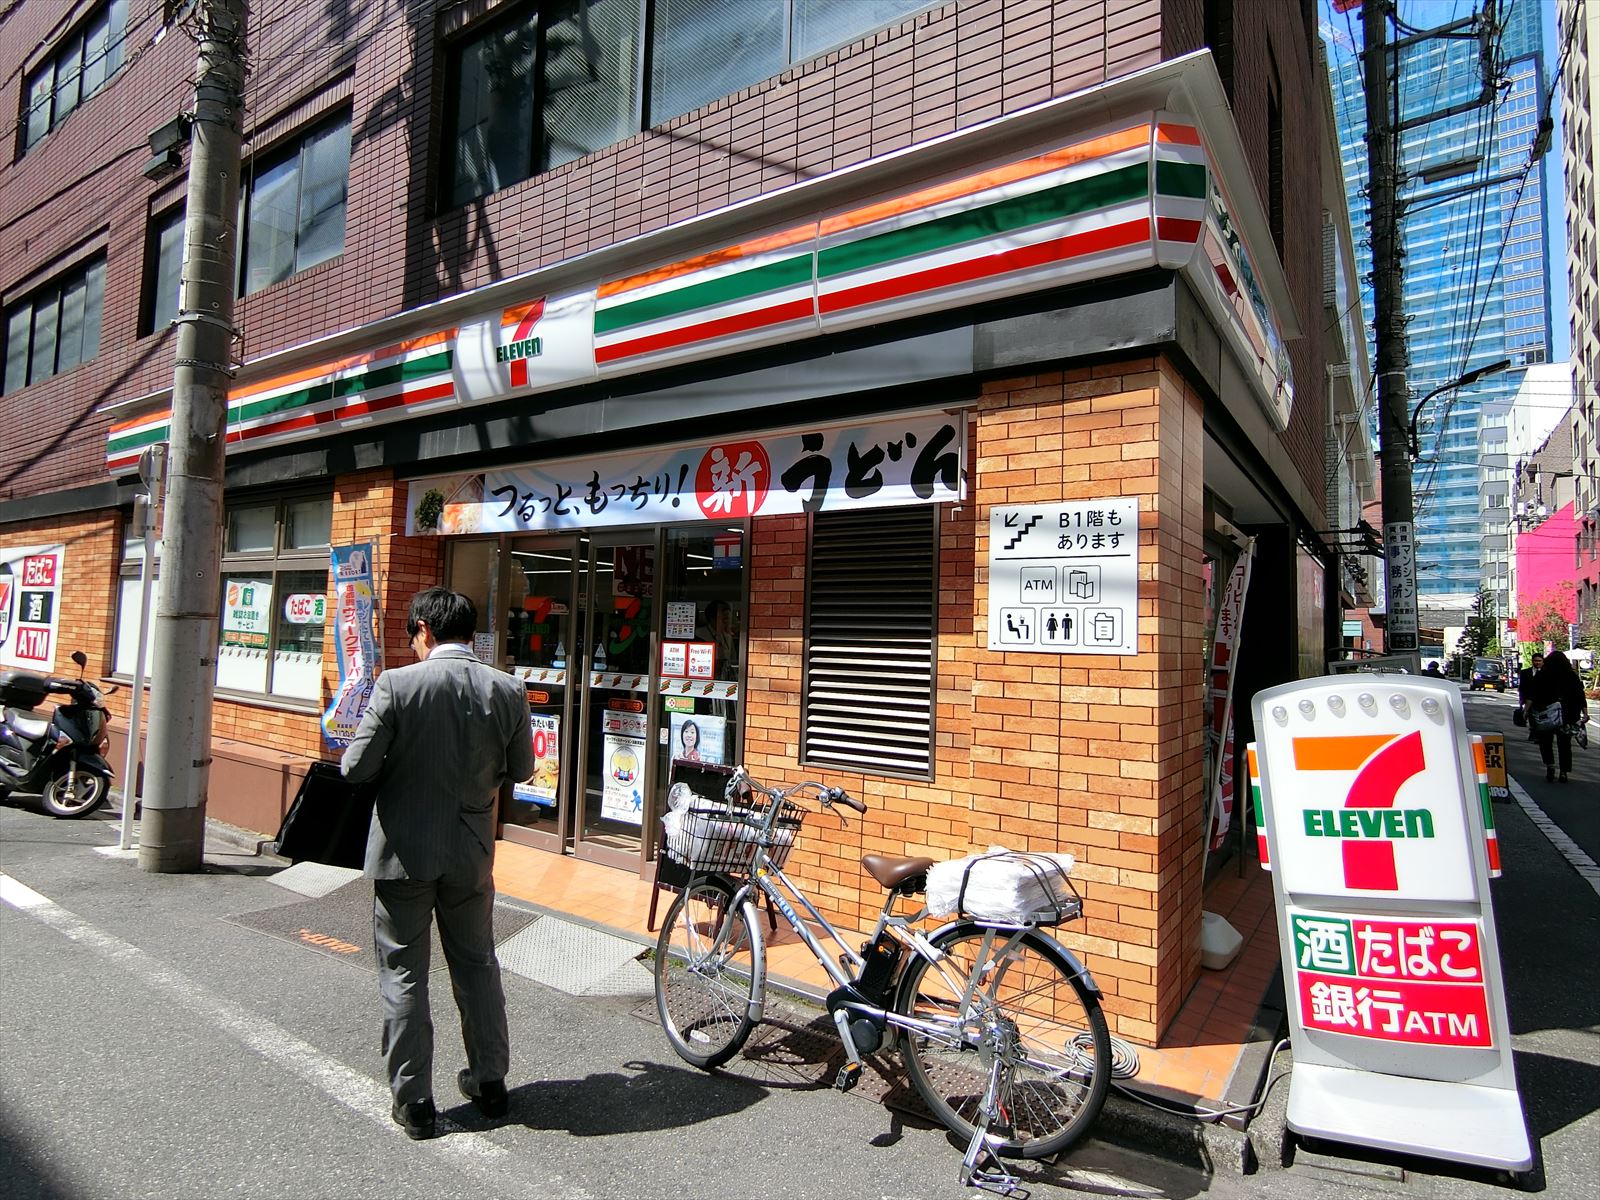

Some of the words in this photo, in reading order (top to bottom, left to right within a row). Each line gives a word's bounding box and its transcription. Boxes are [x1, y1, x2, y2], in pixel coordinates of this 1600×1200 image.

[702, 447, 763, 515] 新
[781, 424, 960, 512] うどん
[1057, 531, 1125, 550] あります
[25, 558, 53, 584] たばこ
[1024, 579, 1053, 591] ATM
[1390, 545, 1403, 598] 事務所
[1401, 544, 1413, 598] マンション
[28, 594, 44, 621] 酒
[290, 598, 311, 616] たばこ
[314, 598, 324, 616] 酒
[16, 629, 49, 658] ATM
[1296, 918, 1350, 971] 酒
[1356, 924, 1478, 978] たばこ
